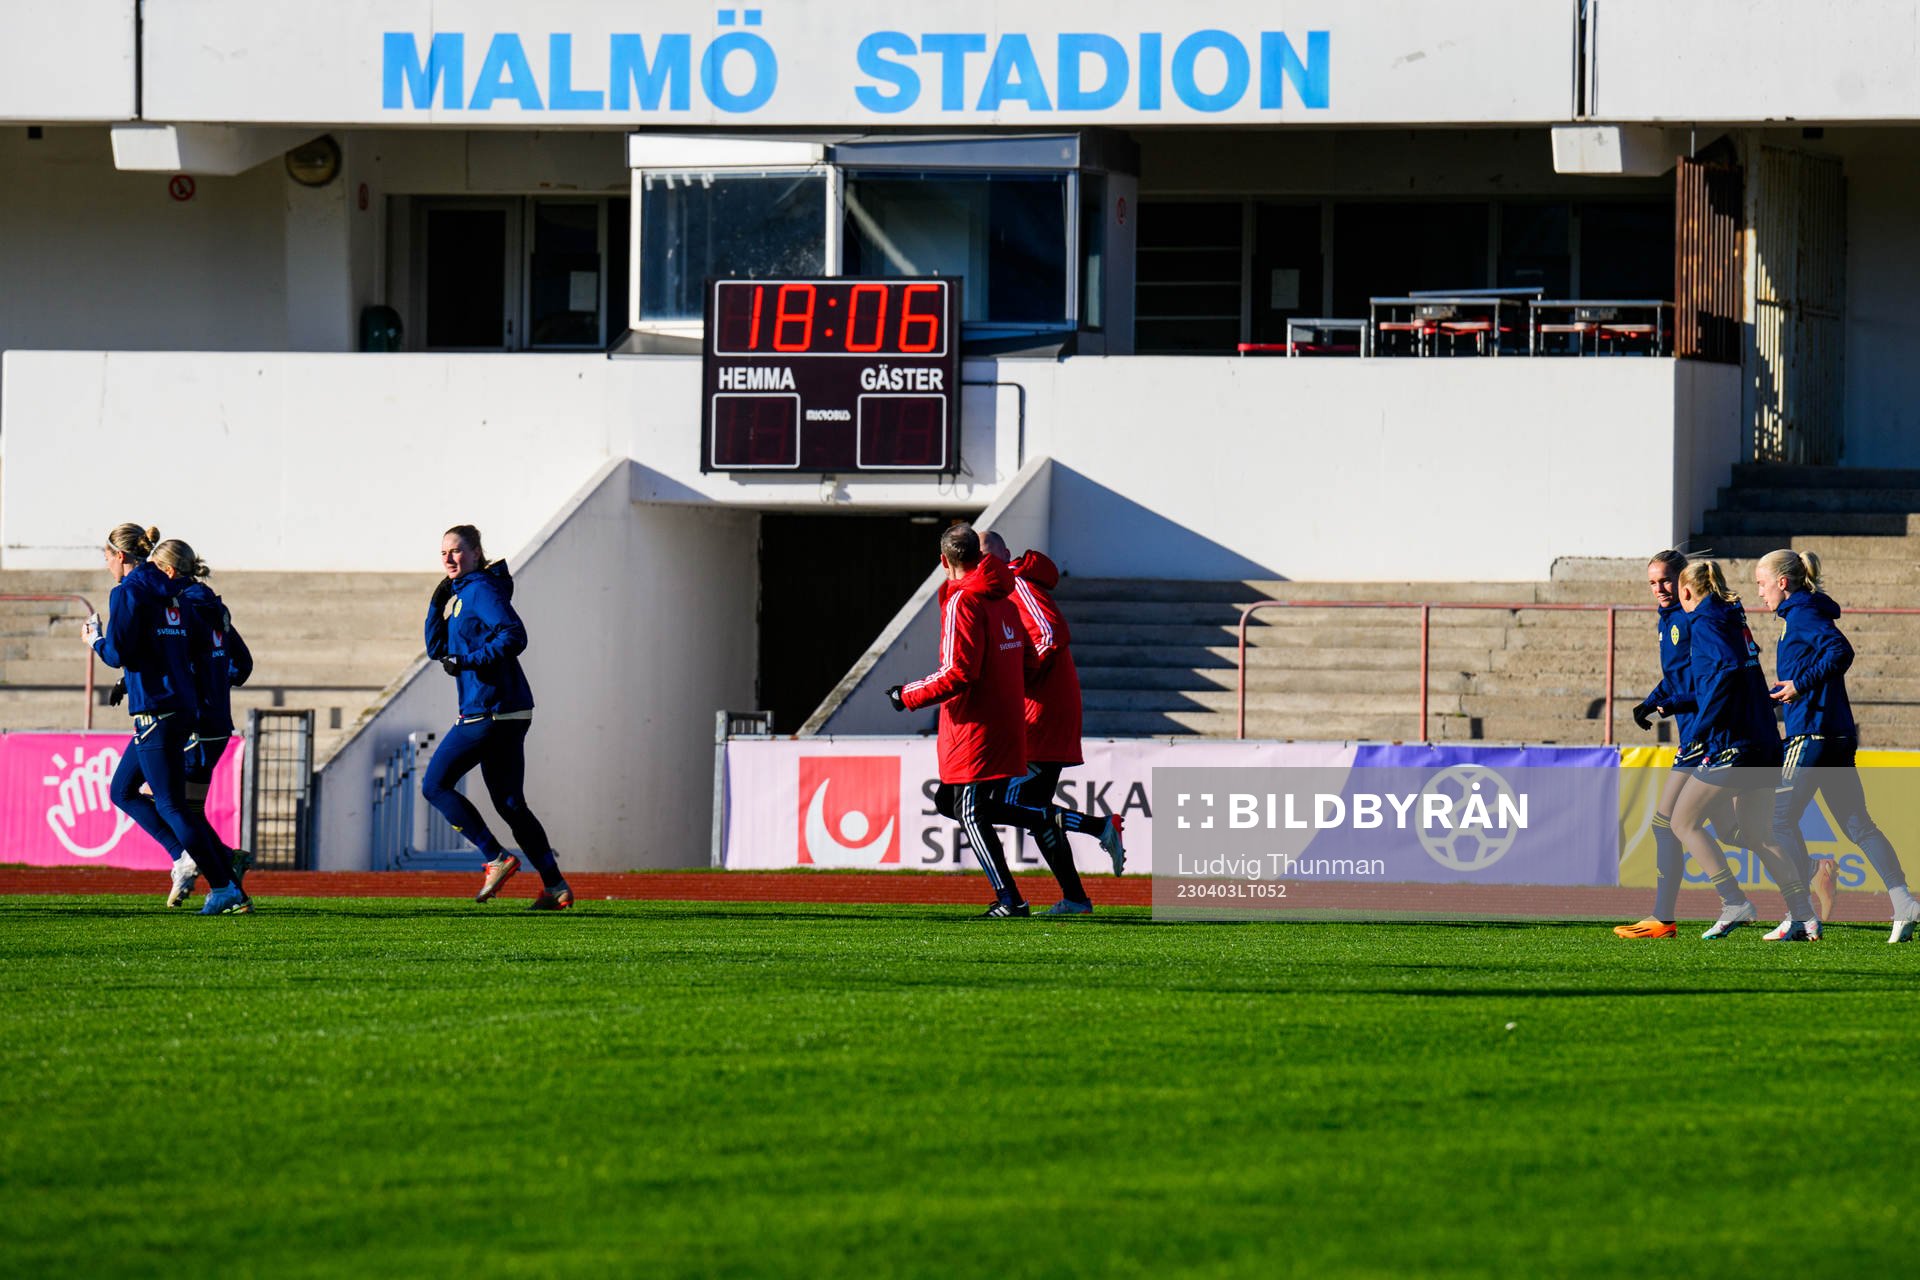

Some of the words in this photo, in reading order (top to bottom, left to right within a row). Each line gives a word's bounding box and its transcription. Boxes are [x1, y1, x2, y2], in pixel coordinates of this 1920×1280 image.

[382, 9, 778, 114] MALMÖ
[854, 29, 1331, 114] STADION
[748, 283, 940, 352] 18:06
[718, 366, 796, 390] HEMMA
[860, 364, 944, 391] GÄSTER
[921, 779, 1152, 818] SSKA
[921, 826, 1039, 864] SPL
[1682, 848, 1866, 888] adis
